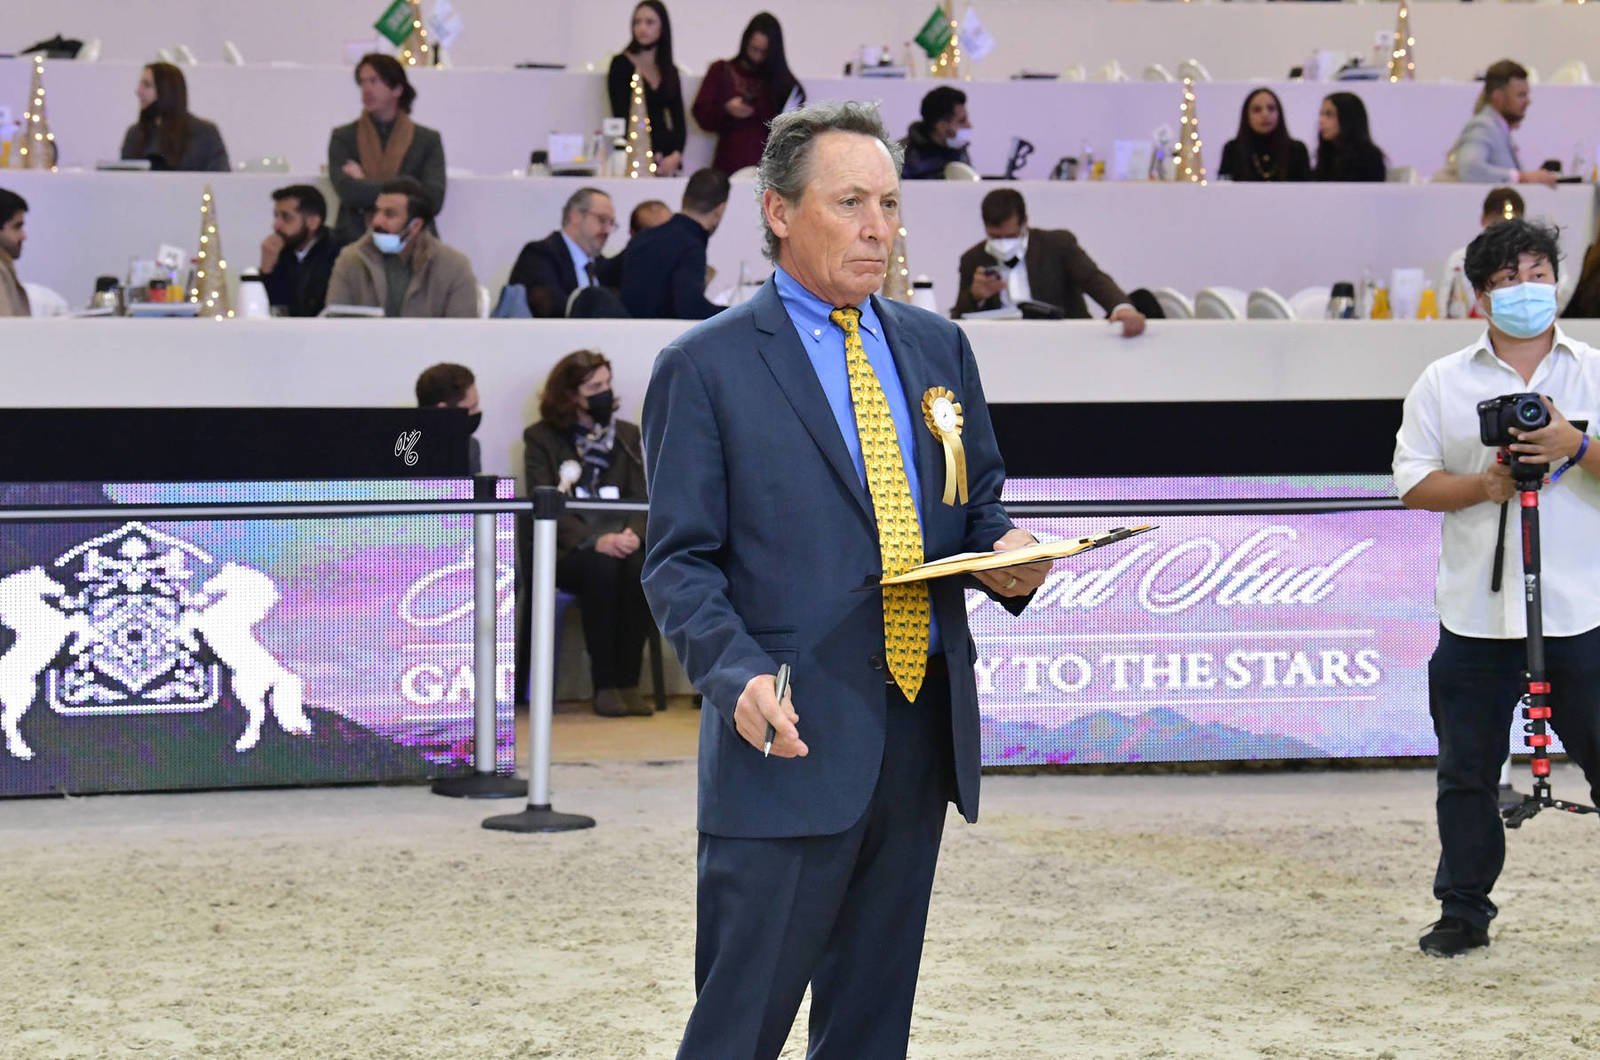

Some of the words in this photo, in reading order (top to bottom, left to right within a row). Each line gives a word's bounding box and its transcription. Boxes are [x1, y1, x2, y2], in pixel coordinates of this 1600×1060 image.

[1139, 524, 1374, 613] Stud
[1011, 654, 1091, 693] TO
[1102, 652, 1218, 690] THE
[1225, 649, 1382, 688] STARS
